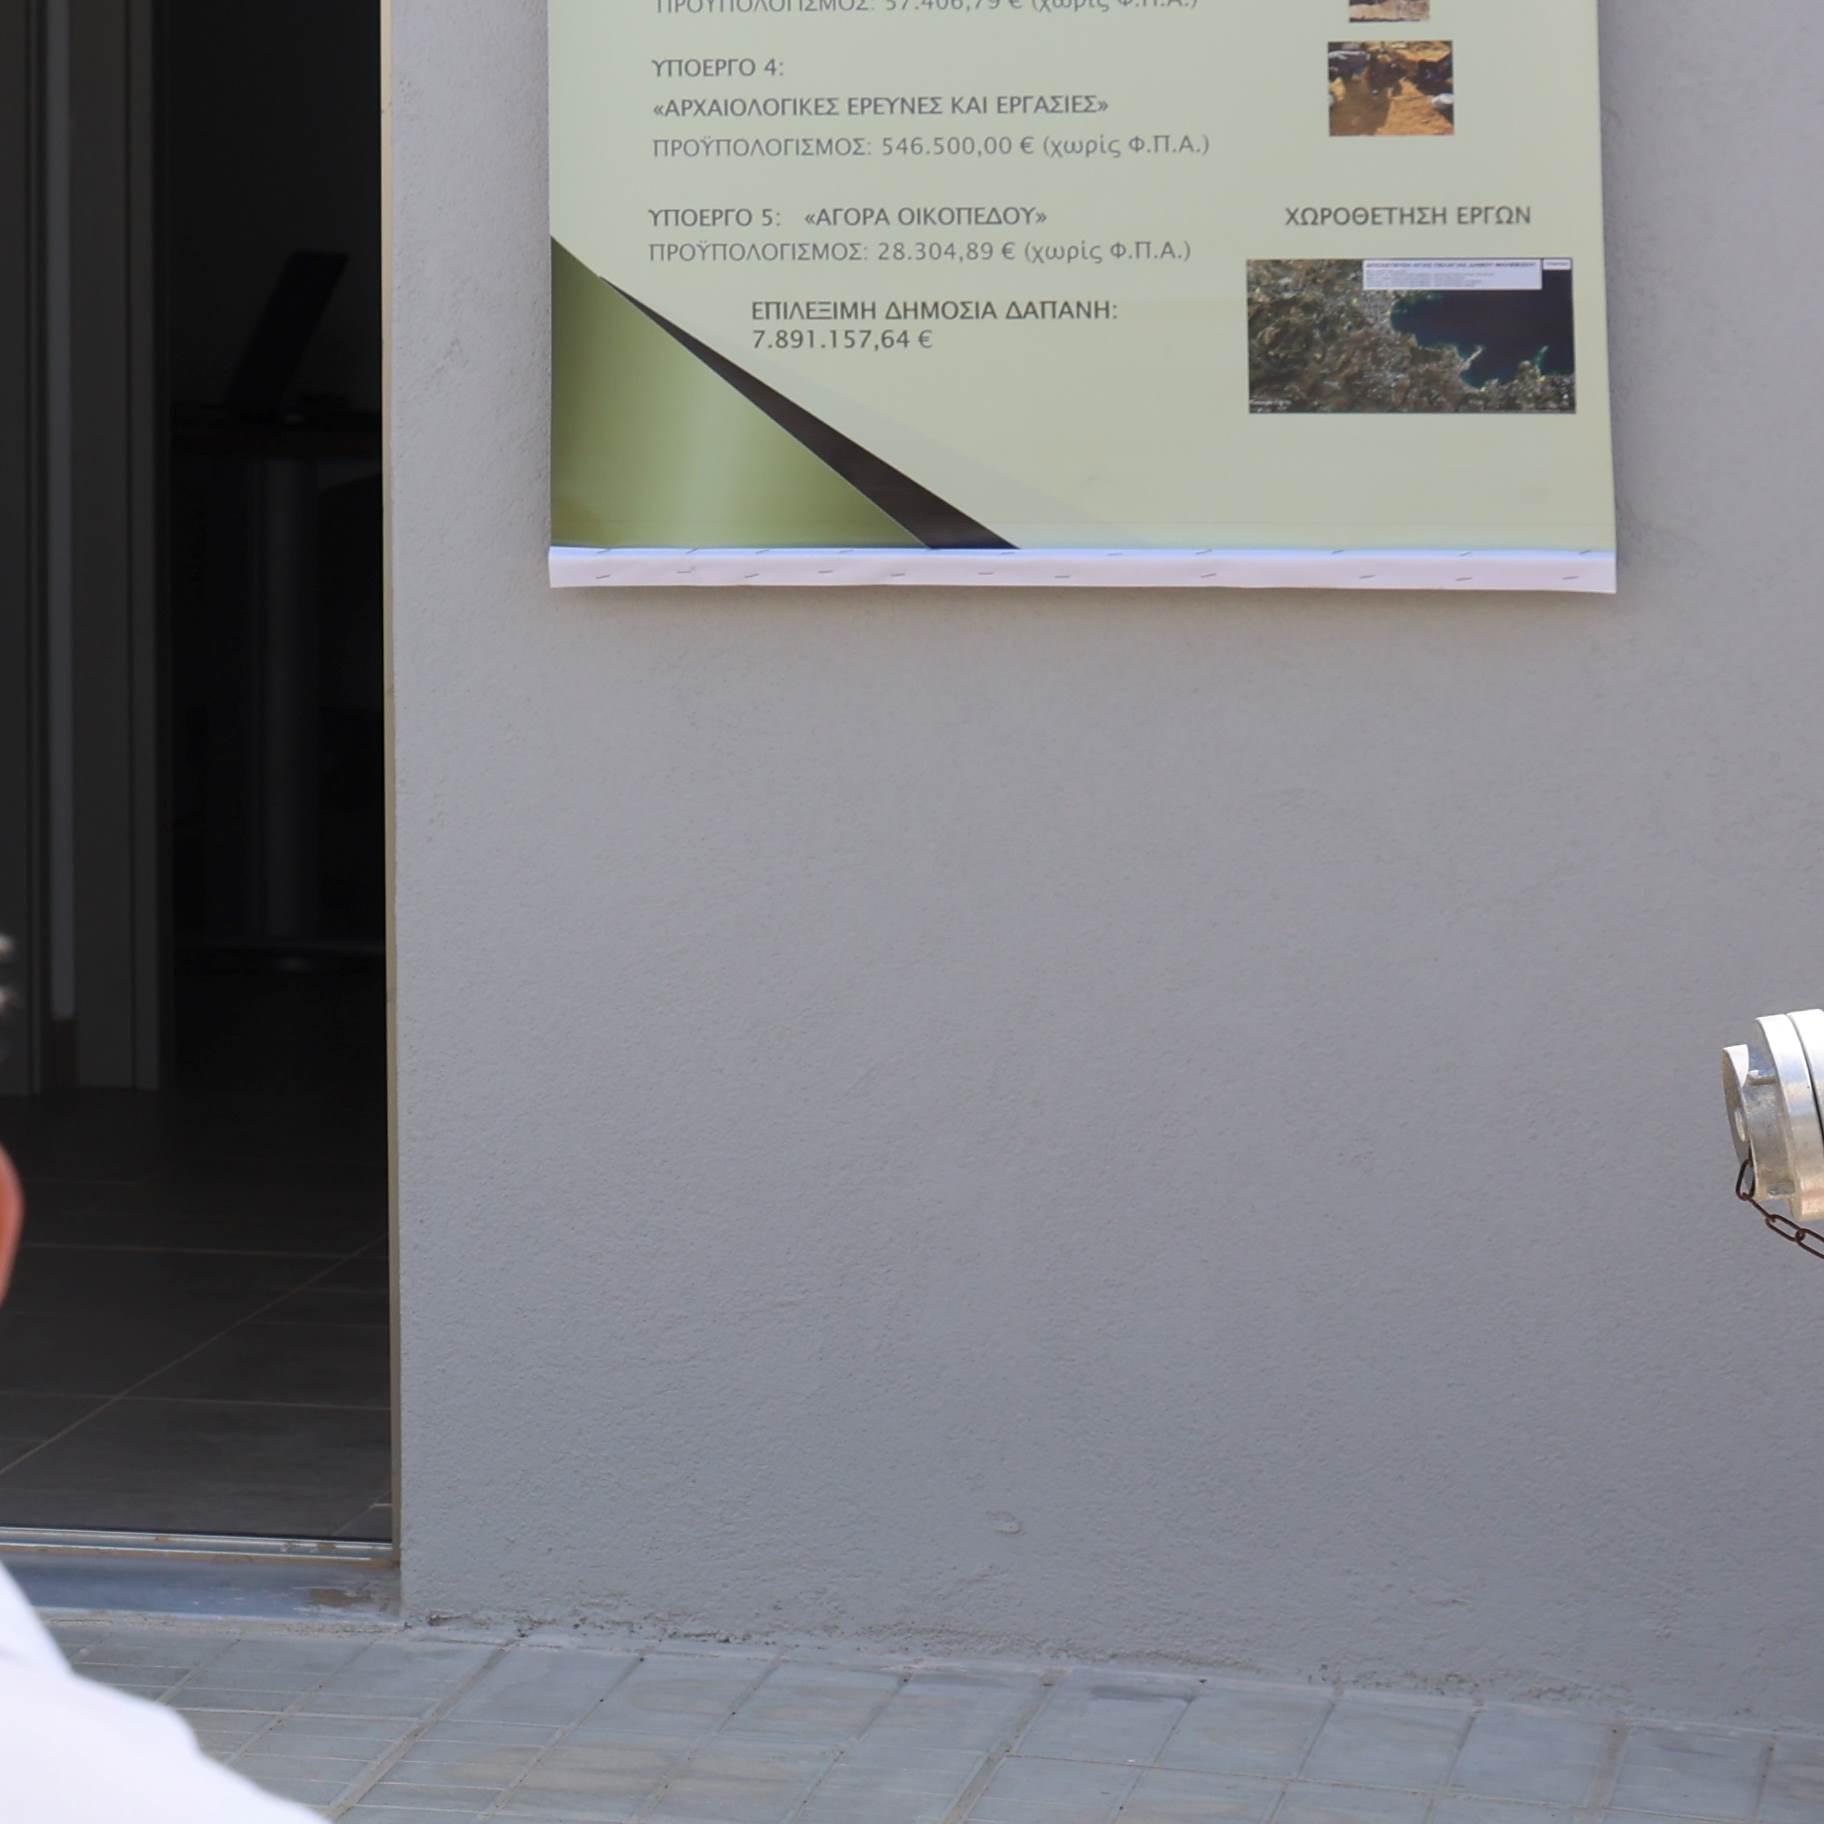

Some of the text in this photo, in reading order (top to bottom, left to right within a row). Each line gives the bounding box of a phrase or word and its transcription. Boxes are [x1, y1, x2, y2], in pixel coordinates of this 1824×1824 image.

[652, 58, 783, 77] ΥΠΟΕΡΓΟ 4:
[654, 95, 1108, 116] «ΑΡΧΑΙΟΛΟΓΙΚΕΣ ΕΡΕΥΝΕΣ ΚΑΙ ΕΡΓΑΣΙΕΣ»
[648, 207, 1046, 226] ΥΠΟΕΡΓΟ 5: «ΑΓΟΡΑ ΟΙΚΟΠΕΔΟΥ»
[1286, 206, 1530, 226] ΧΩΡΟΘΕΤΗΣΗ ΕΡΓΩΝ
[752, 301, 1116, 320] ΕΠΙΛΕΞΙΜΗ ΔΗΜΟΣΙΑ ΔΑΠΑΝΗ:
[754, 330, 932, 351] 7.891.157,64 €
